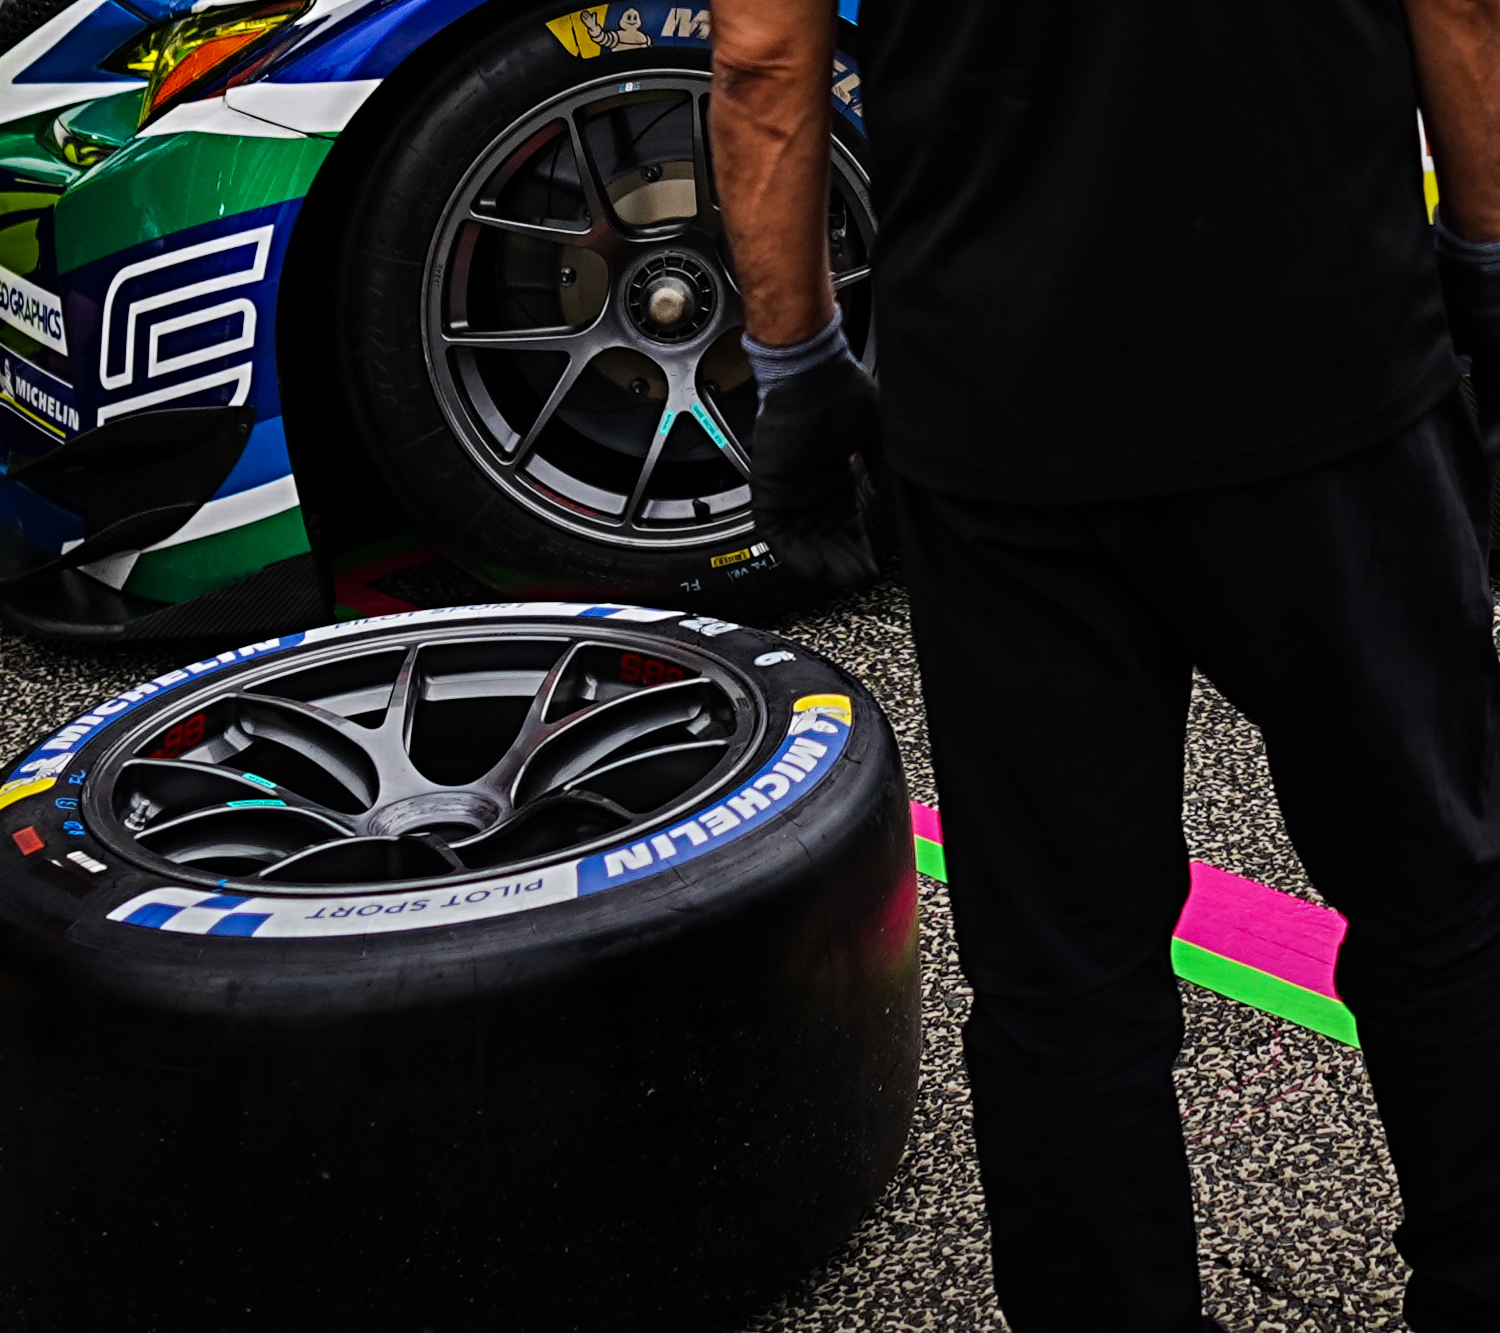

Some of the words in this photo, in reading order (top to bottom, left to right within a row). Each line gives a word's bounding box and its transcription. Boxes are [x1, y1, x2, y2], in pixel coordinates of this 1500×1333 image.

[16, 376, 80, 432] MICHELIN
[52, 637, 282, 753] MICHELIN
[605, 737, 828, 877] MICHELIN
[304, 897, 430, 921] SPORT
[442, 878, 543, 907] PILOT
